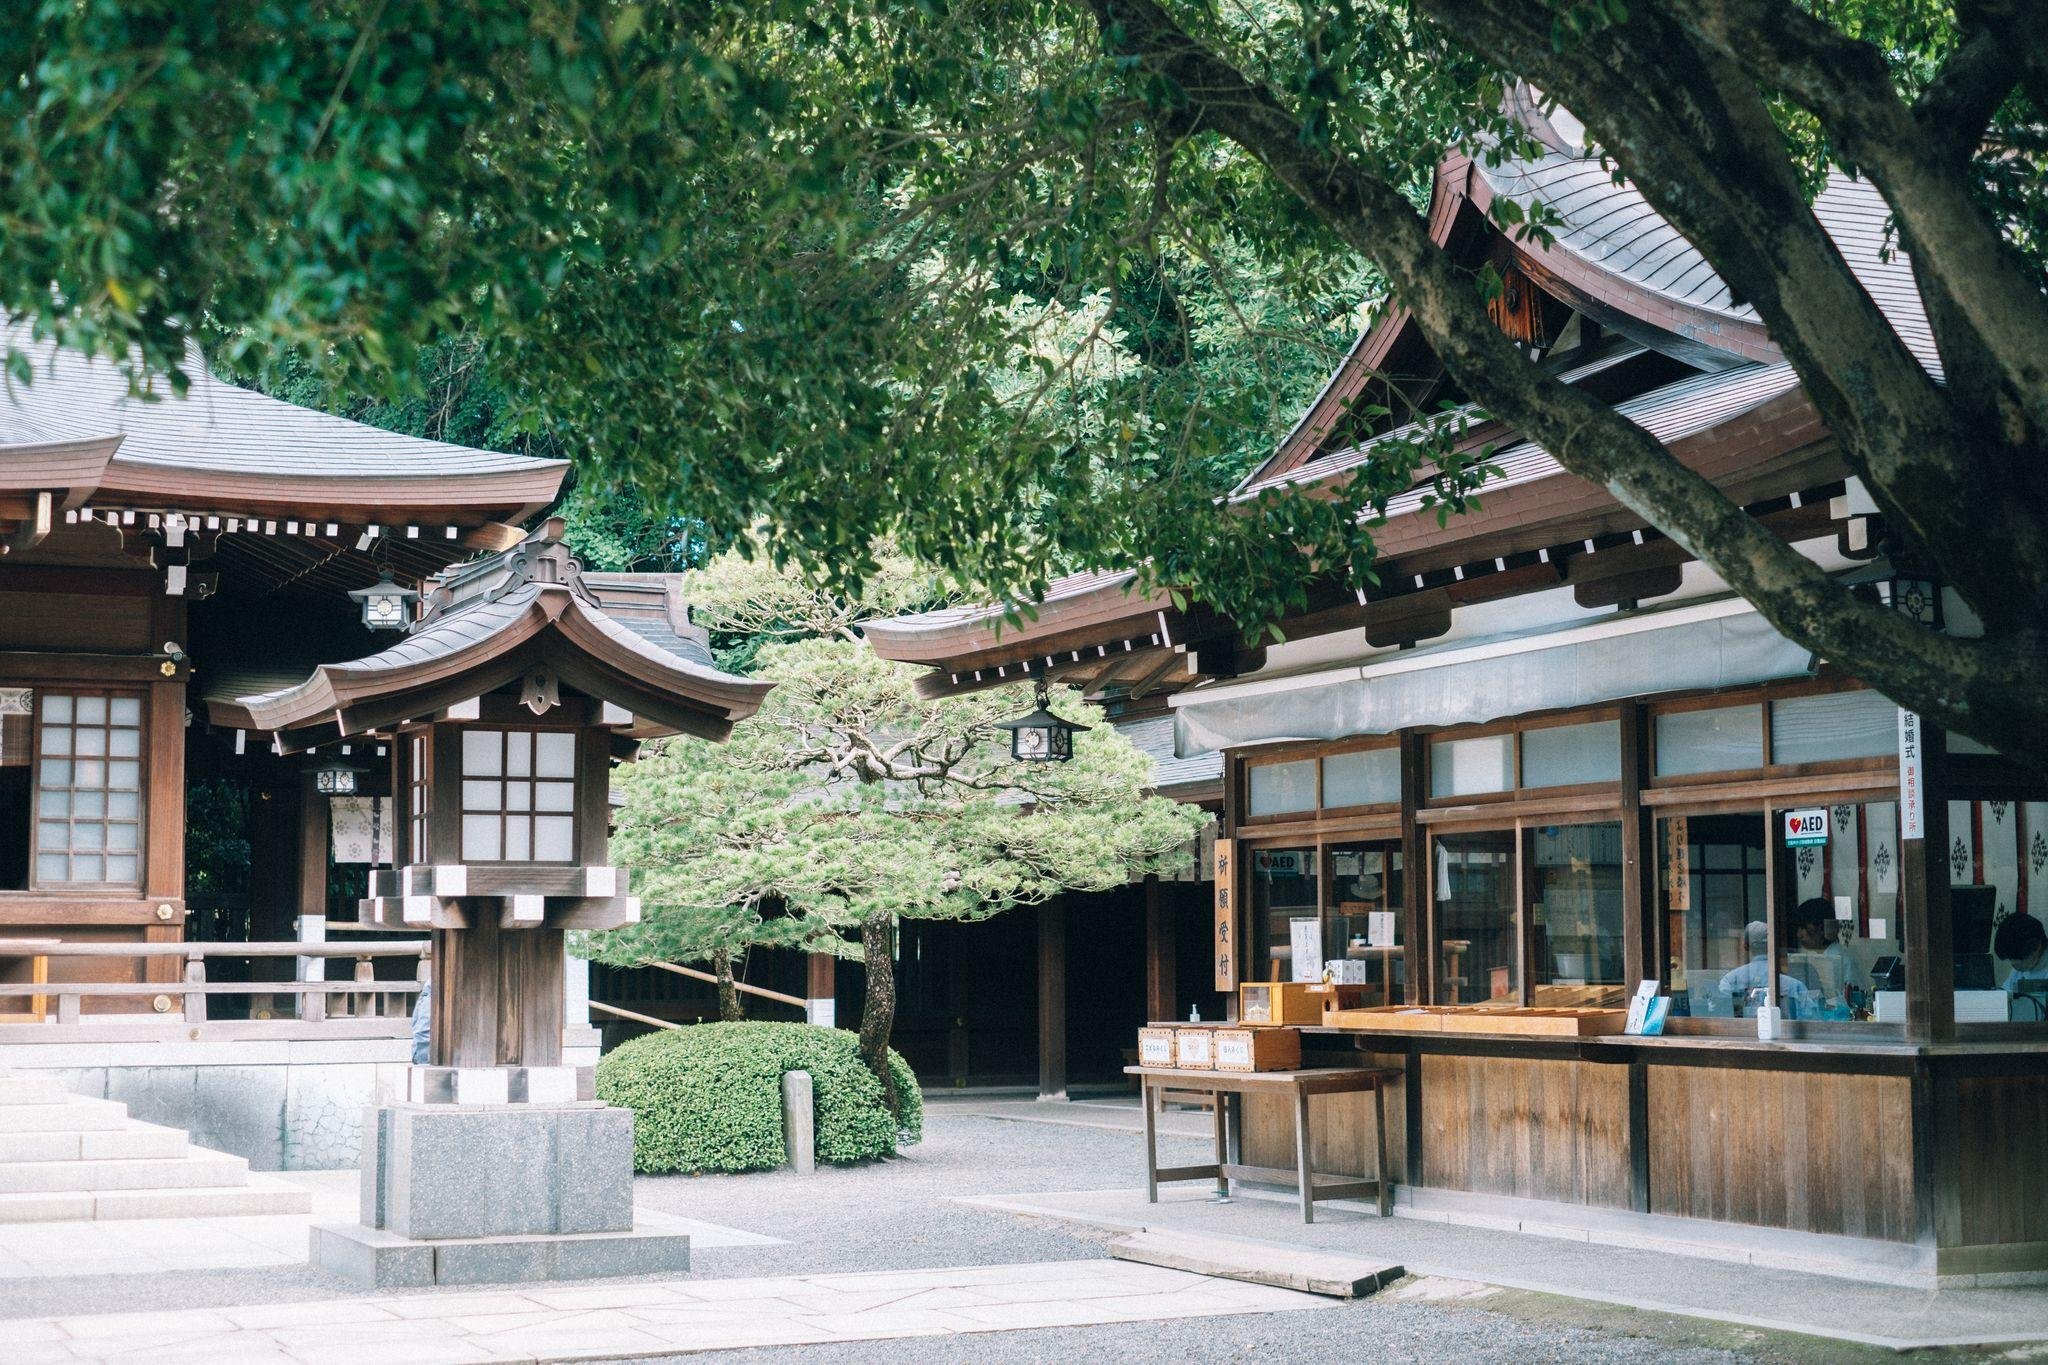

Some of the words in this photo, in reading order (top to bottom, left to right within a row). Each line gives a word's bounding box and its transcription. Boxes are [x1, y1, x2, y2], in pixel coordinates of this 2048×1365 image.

[1903, 706, 1916, 759] 結婚式
[1800, 816, 1823, 832] AED
[1907, 766, 1917, 833] 御相談承り所
[1271, 856, 1295, 868] AED
[1218, 854, 1229, 977] 祈願受付
